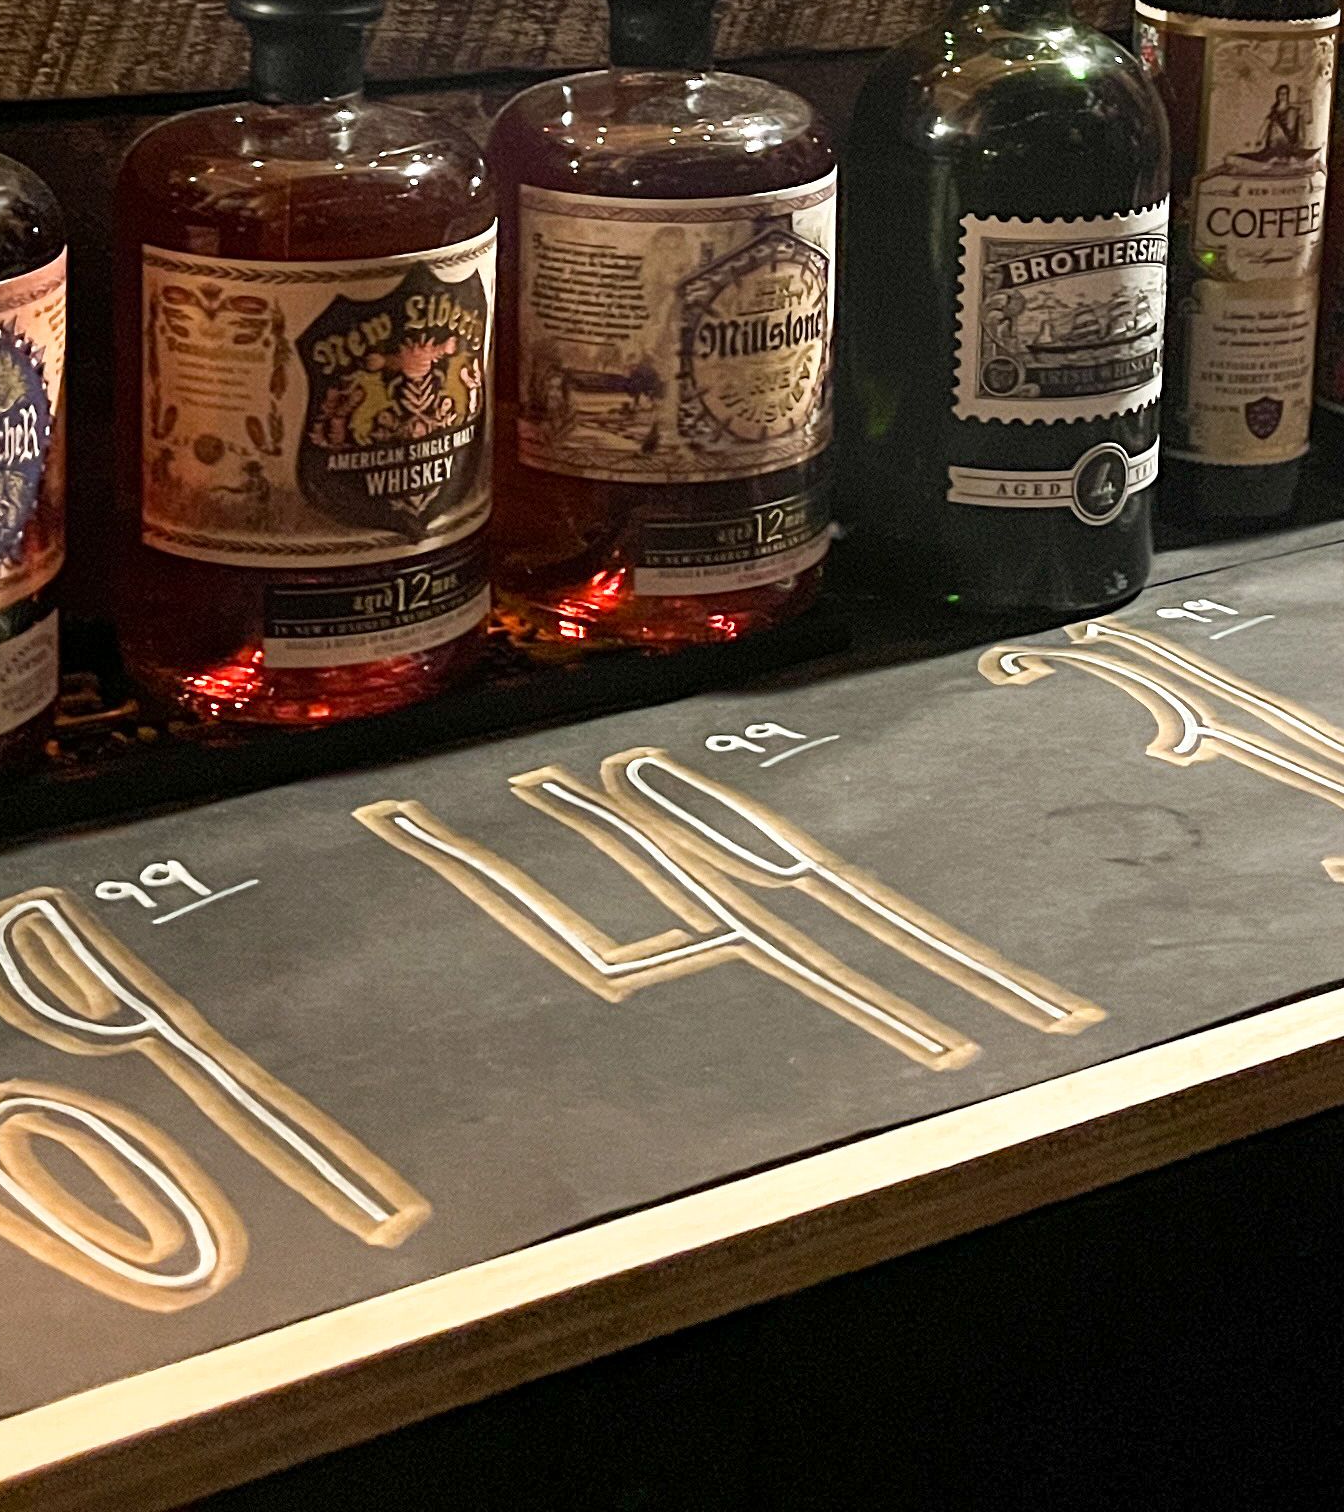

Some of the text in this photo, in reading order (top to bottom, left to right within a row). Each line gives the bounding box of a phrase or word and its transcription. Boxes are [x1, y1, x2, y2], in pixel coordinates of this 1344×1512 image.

[1206, 201, 1321, 239] COFFEE
[327, 443, 404, 471] AMERICAN
[407, 433, 451, 461] SINGLE
[365, 455, 455, 498] WHISKEY
[995, 461, 1118, 507] AGED 4
[755, 508, 785, 544] 12
[394, 571, 432, 613] 12
[1155, 596, 1240, 627] 99
[91, 856, 220, 912] 99
[352, 719, 1111, 1074] 49 99
